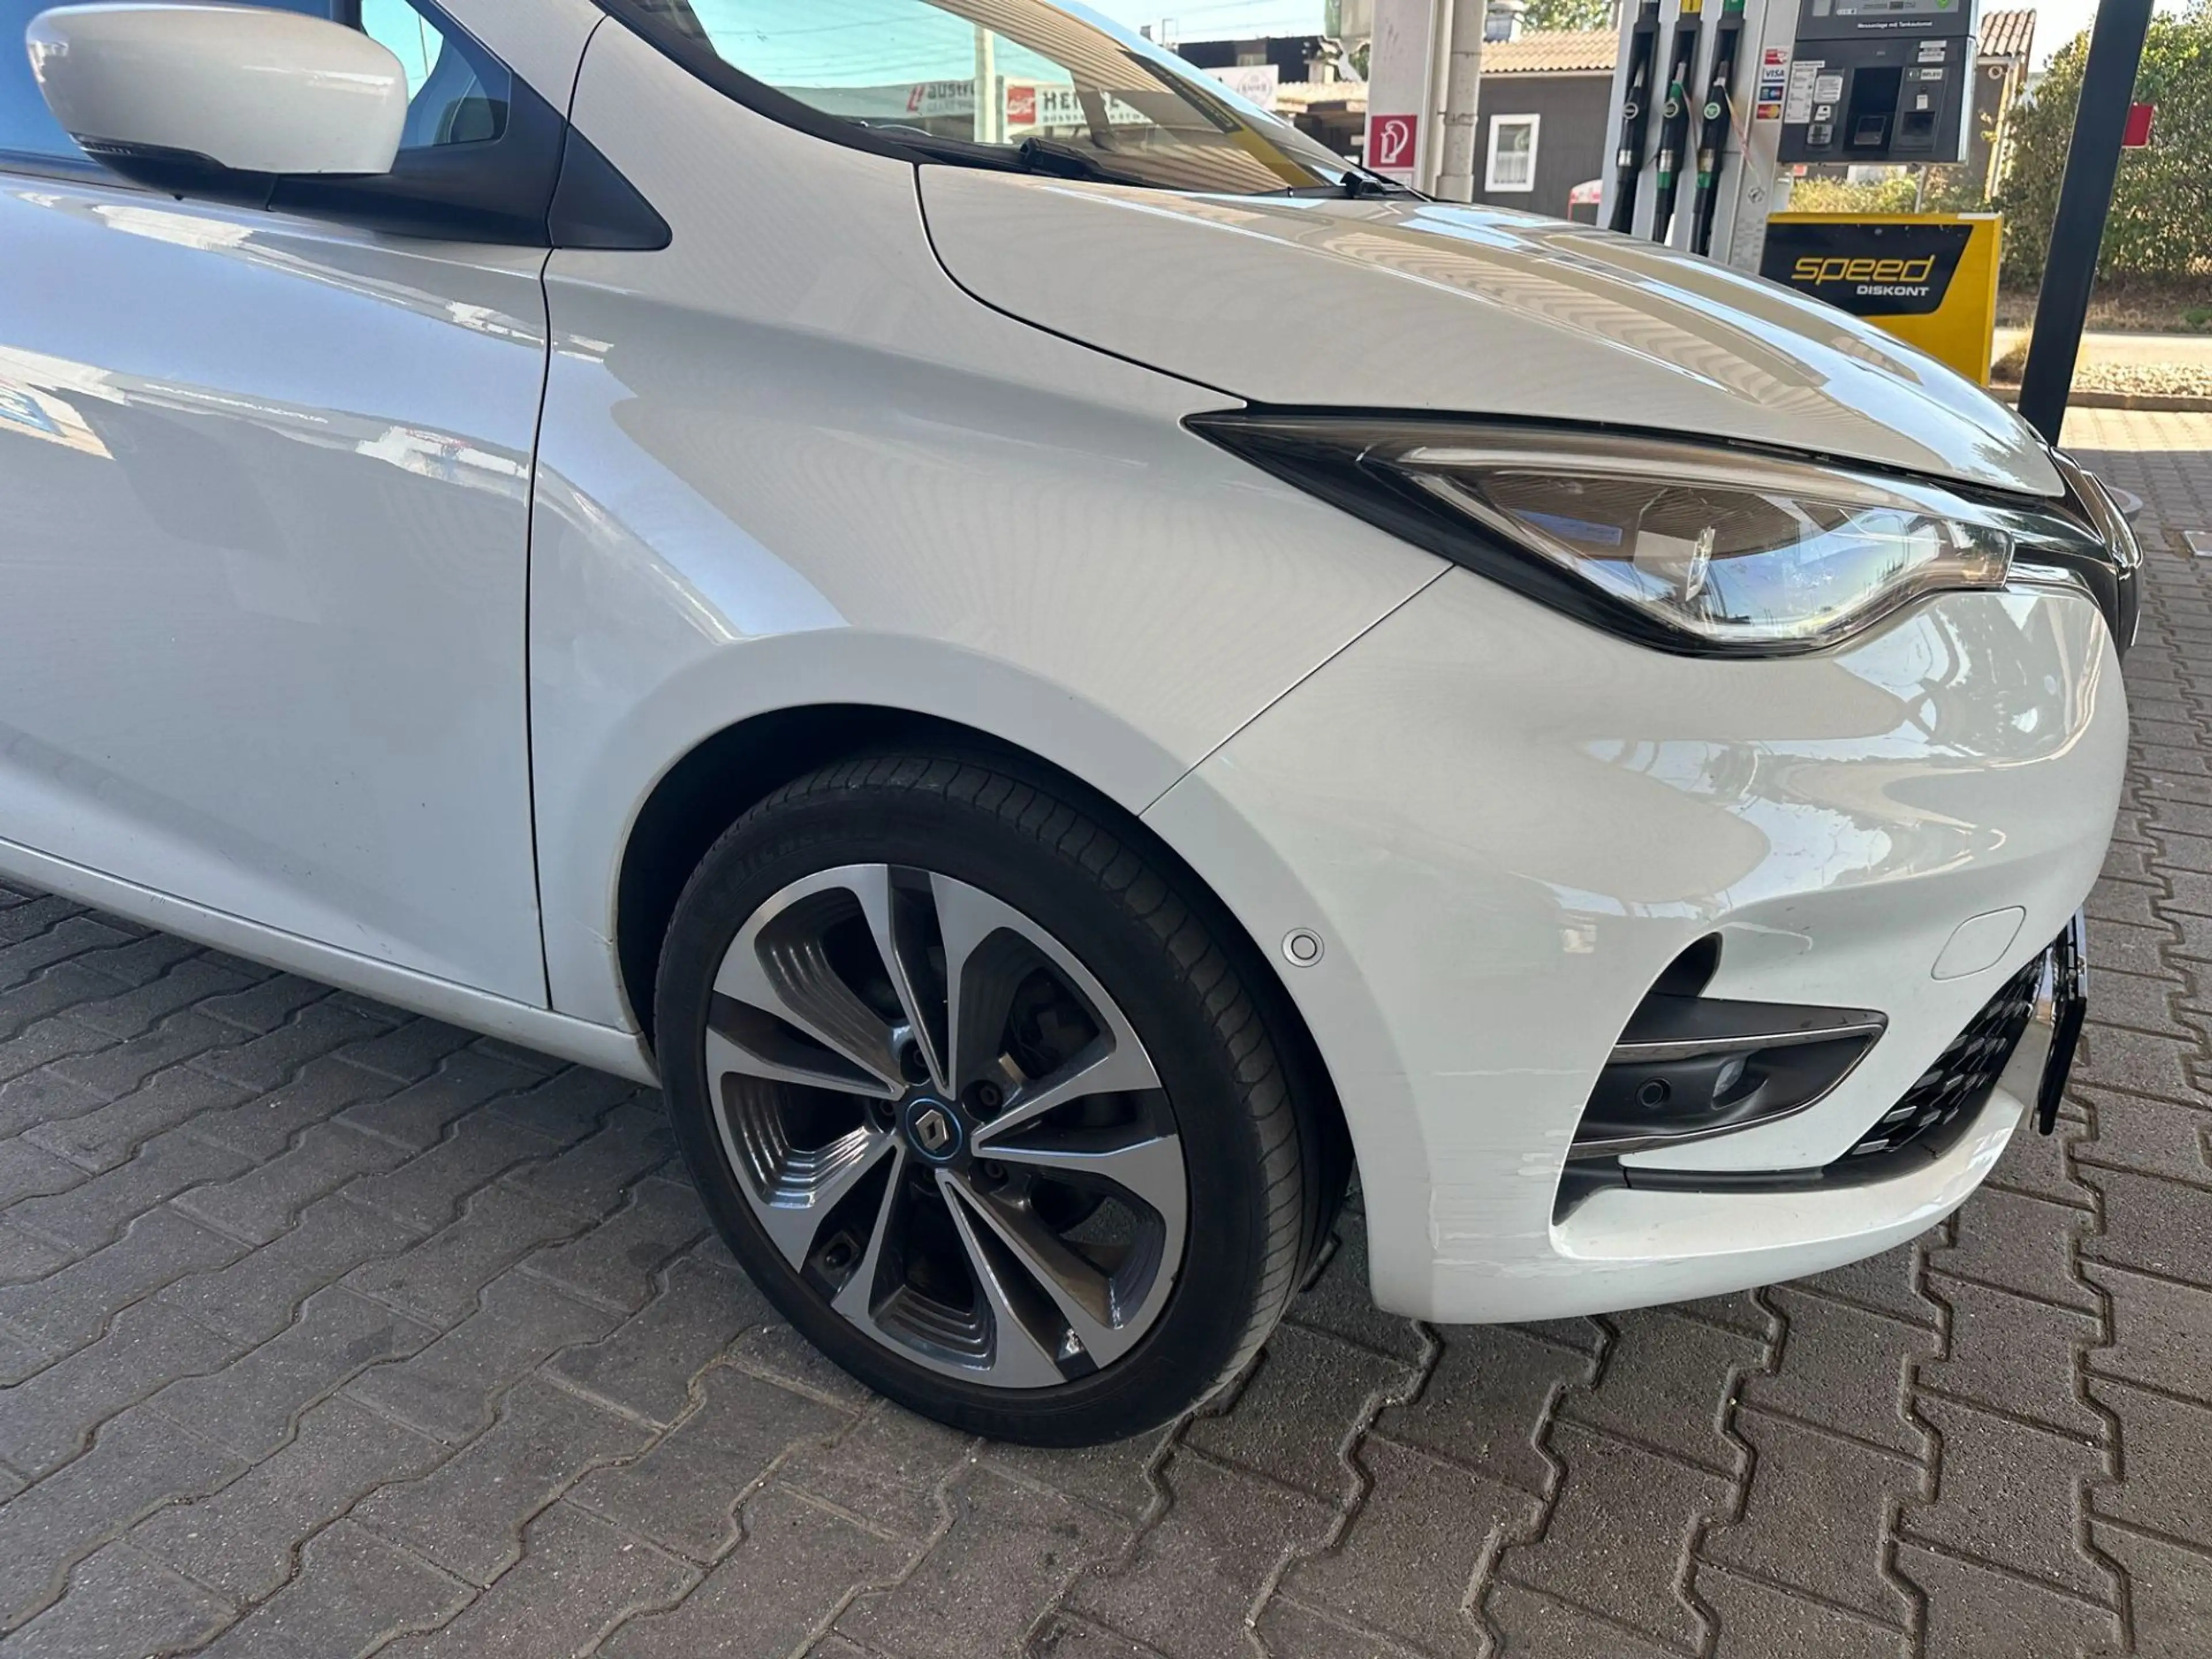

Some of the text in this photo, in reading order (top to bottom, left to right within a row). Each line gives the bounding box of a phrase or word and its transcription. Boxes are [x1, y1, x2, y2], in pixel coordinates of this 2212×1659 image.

[1766, 69, 1785, 78] VISA
[1791, 254, 1936, 286] speed
[1856, 284, 1929, 297] DISKONT
